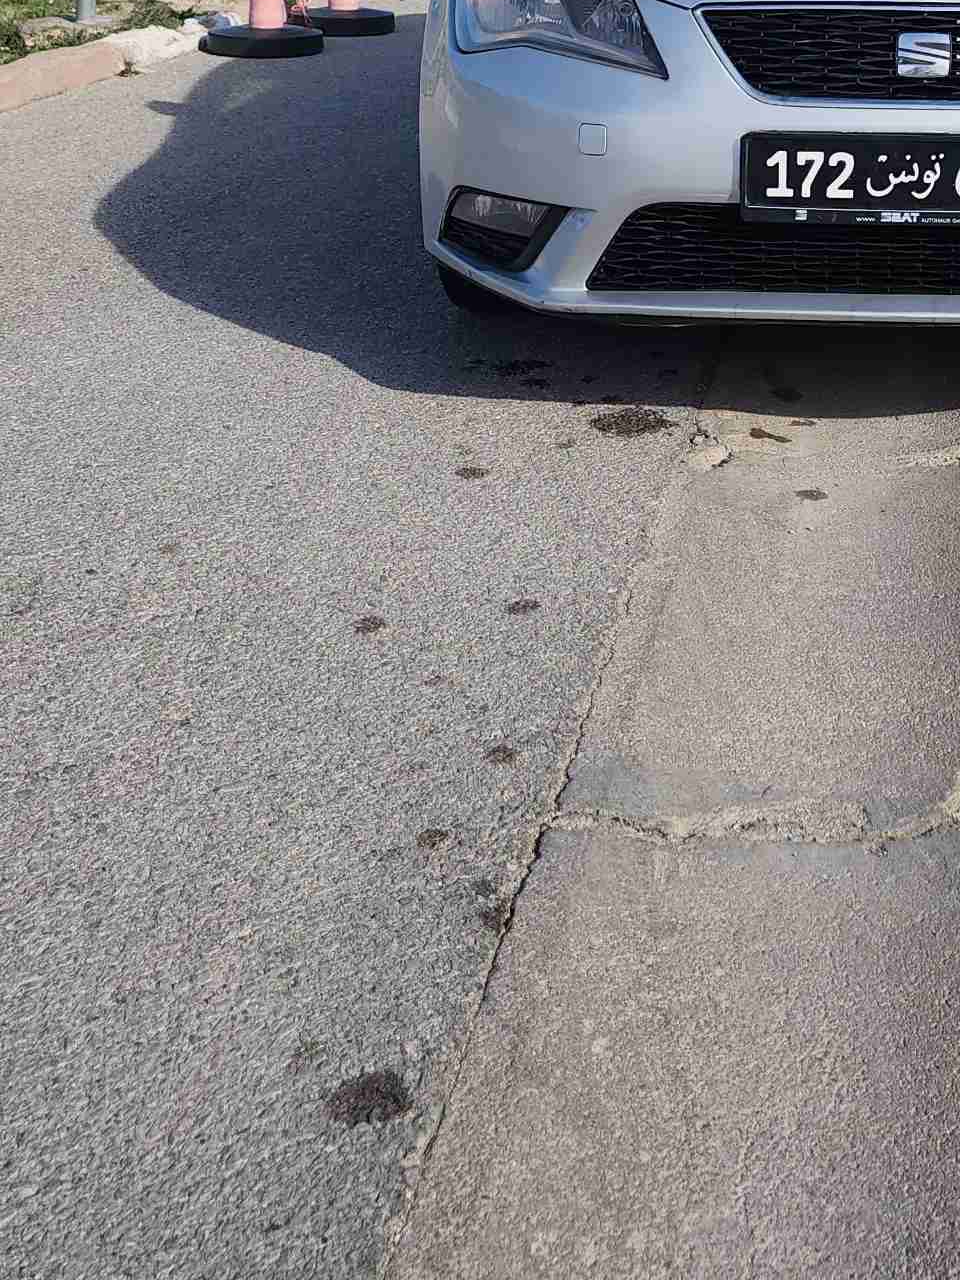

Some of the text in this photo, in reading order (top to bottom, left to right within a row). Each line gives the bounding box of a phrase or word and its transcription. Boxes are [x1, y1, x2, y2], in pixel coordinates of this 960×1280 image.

[766, 150, 855, 199] 172
[866, 152, 945, 200] تونس
[880, 212, 920, 223] SEAT
